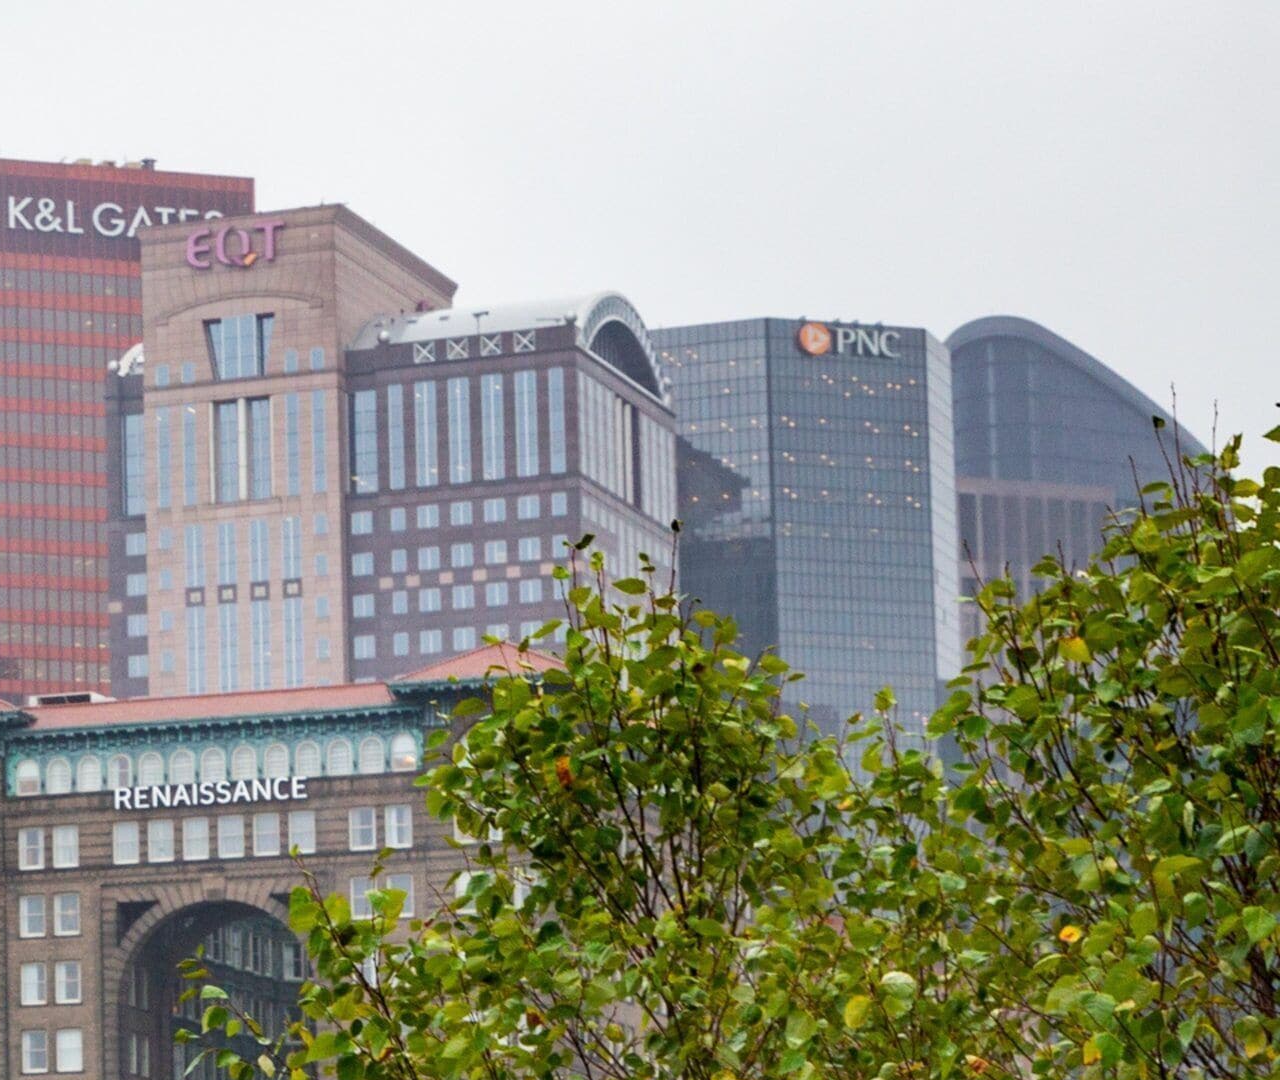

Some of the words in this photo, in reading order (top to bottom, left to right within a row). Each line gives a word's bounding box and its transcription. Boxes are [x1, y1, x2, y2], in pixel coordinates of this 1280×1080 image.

[7, 196, 84, 235] K&L
[92, 202, 224, 237] GAT
[186, 219, 286, 269] EQT
[836, 327, 902, 358] PNC
[113, 775, 309, 811] RENAISSANCE
